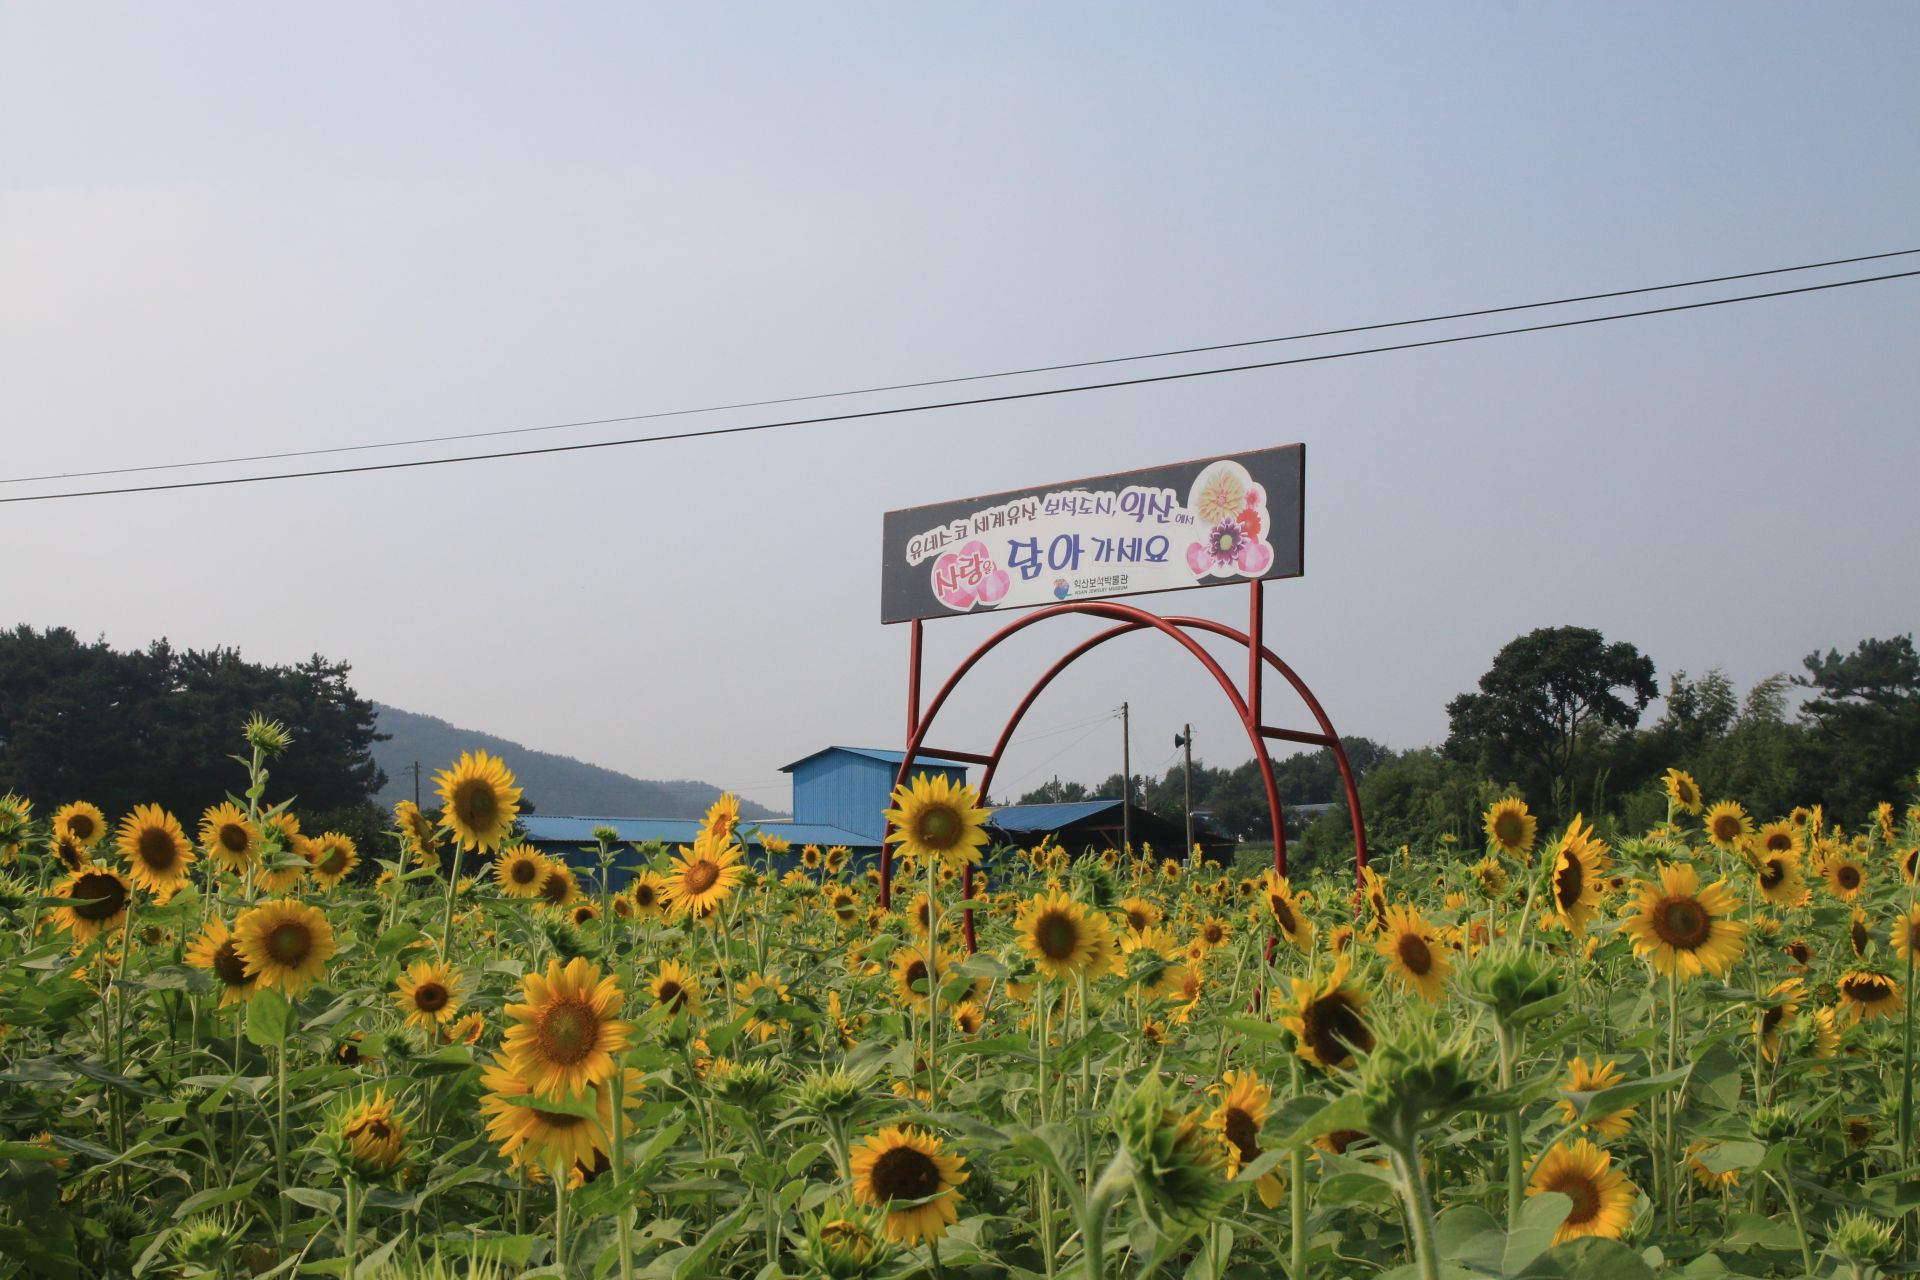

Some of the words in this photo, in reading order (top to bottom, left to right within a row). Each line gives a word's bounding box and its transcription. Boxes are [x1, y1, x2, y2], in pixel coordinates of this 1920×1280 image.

[910, 524, 968, 560] 유네스코
[974, 501, 1037, 535] 세계유산
[1007, 534, 1085, 581] 담아
[1091, 535, 1169, 562] 가세요
[1074, 574, 1128, 589] 익산보석박물관
